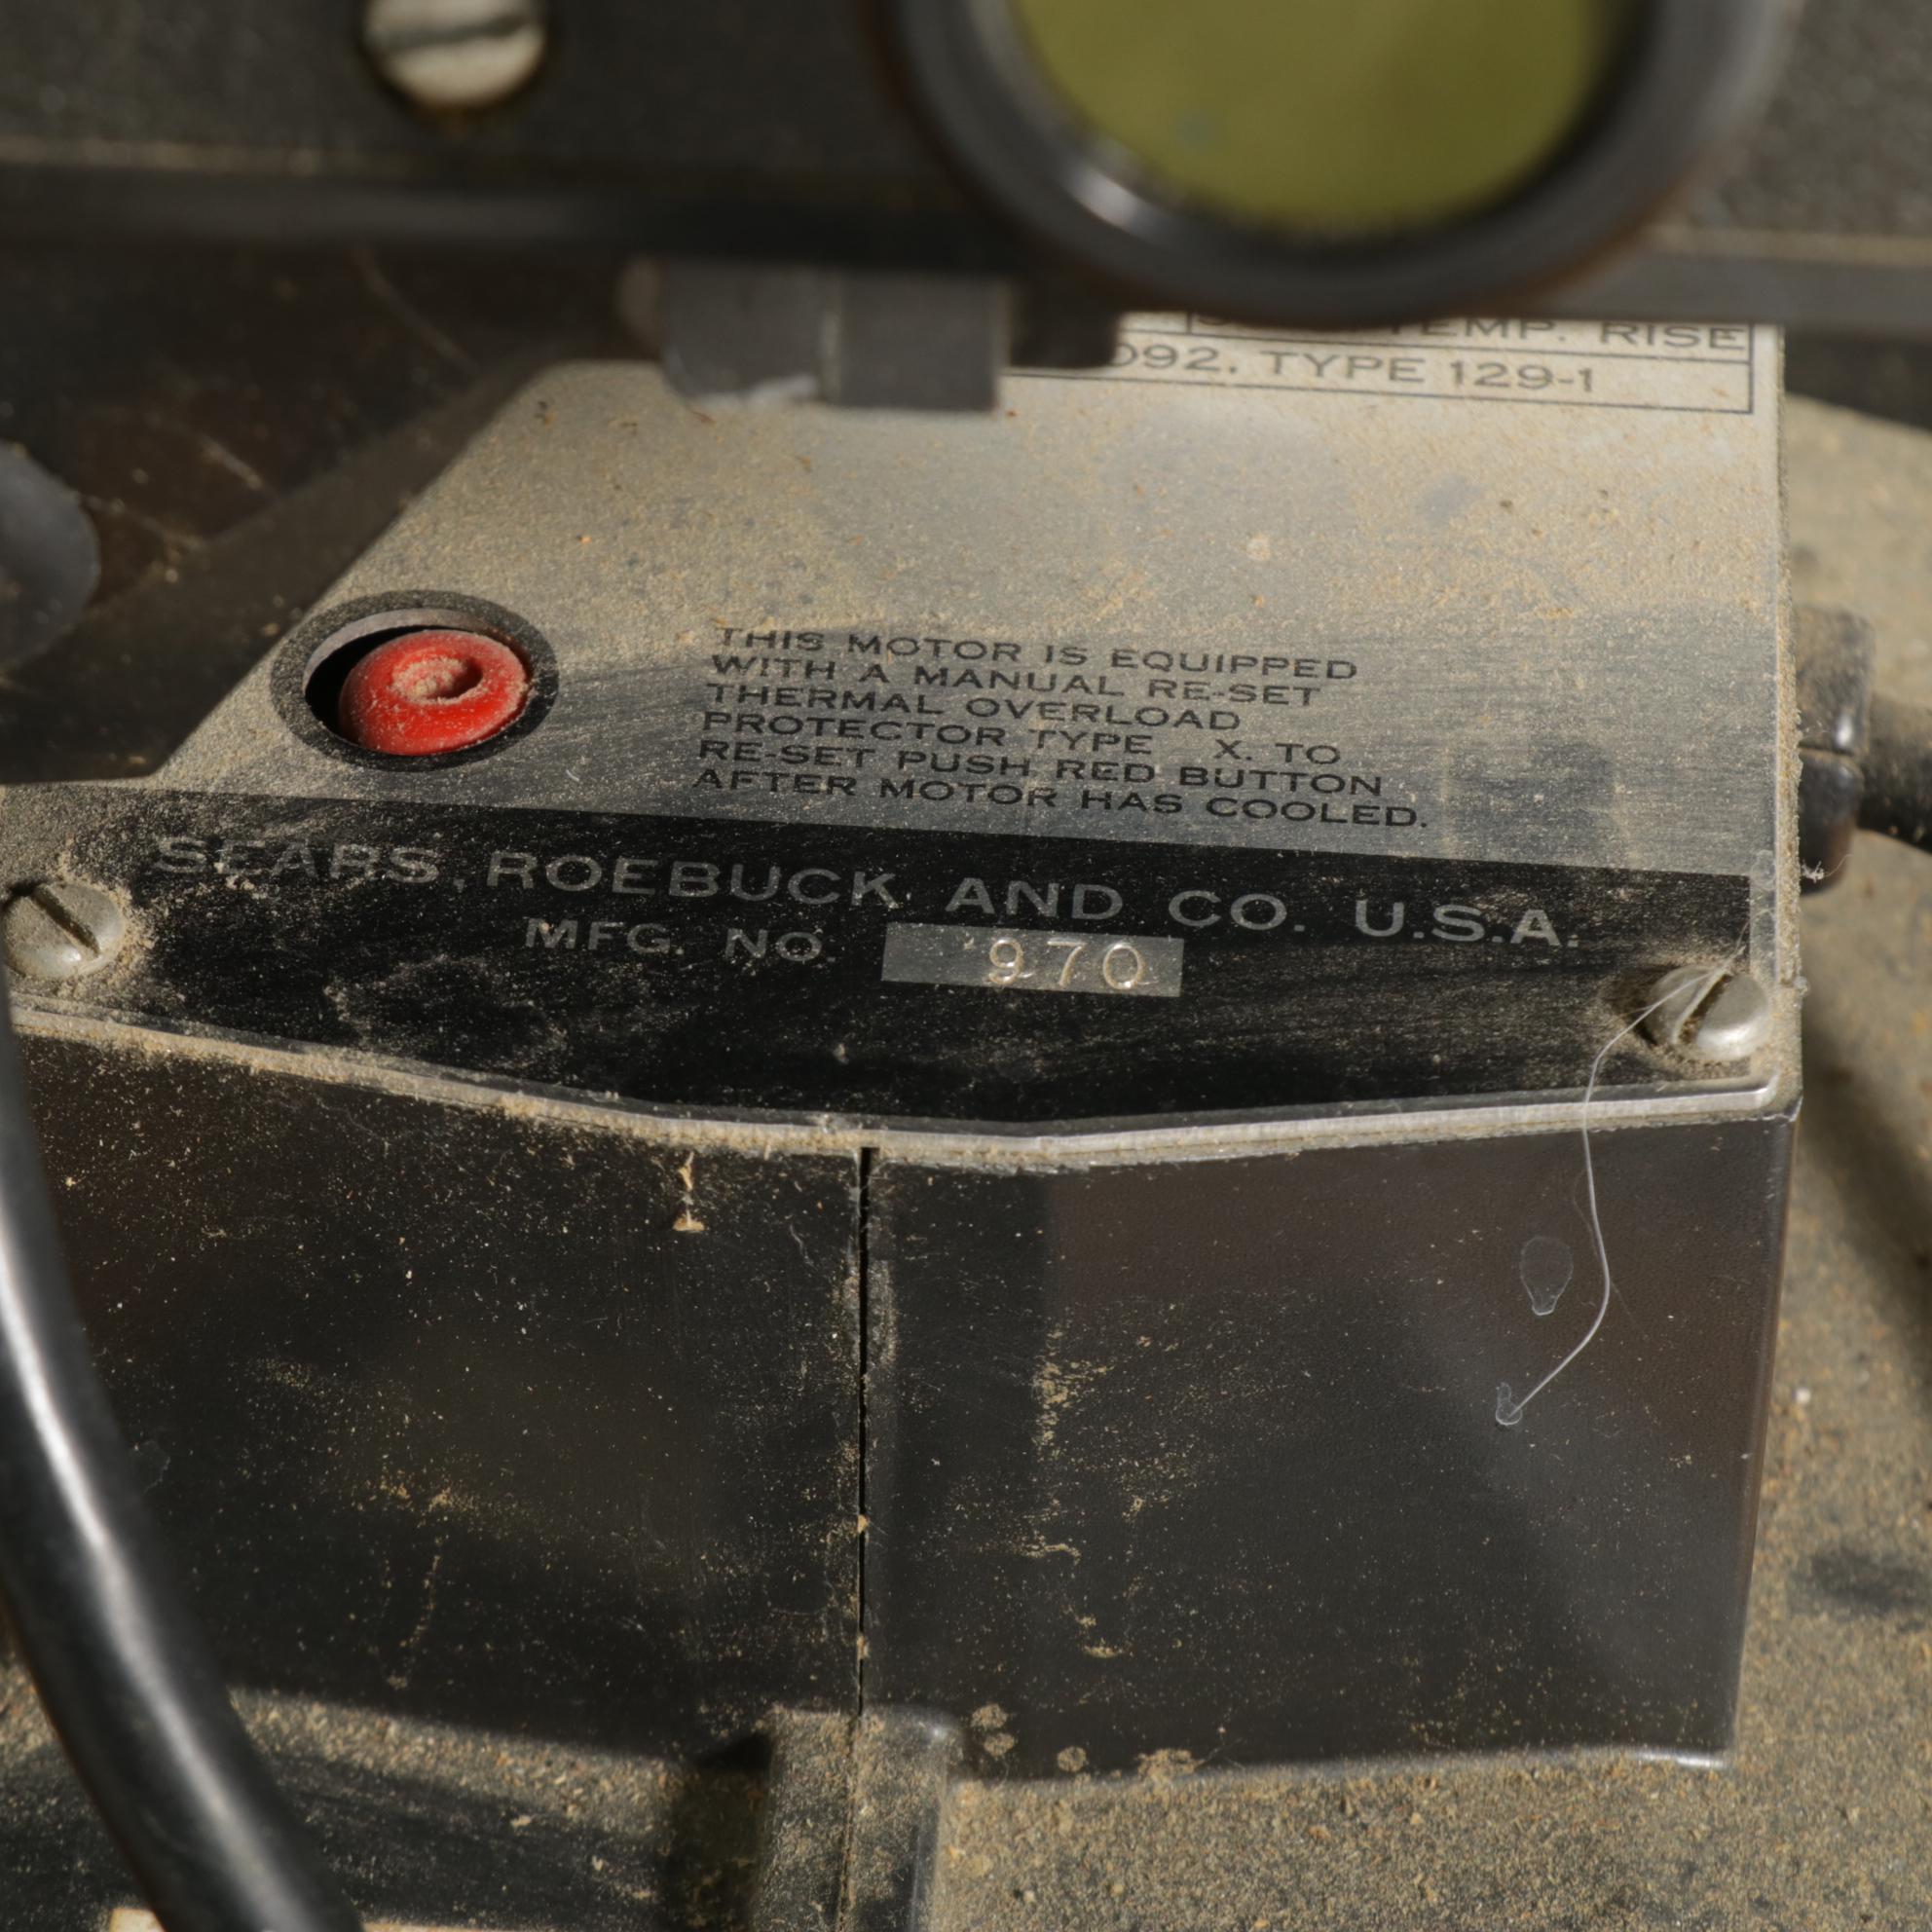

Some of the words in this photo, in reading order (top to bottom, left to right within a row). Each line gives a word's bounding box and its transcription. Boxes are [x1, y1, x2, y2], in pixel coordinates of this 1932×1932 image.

[1600, 321, 1746, 352] RISE
[1260, 350, 1425, 384] TYPE
[1449, 359, 1594, 391] 129-1
[712, 654, 836, 681] WITH
[859, 663, 890, 684] A
[913, 665, 1126, 697] MANUAL
[1148, 679, 1321, 707] RE-SET
[721, 627, 825, 652] THIS
[848, 633, 1022, 662] MOTOR
[1045, 645, 1088, 666] IS
[1110, 650, 1357, 681] EQUIPPED
[706, 683, 945, 715] THERMAL
[965, 697, 1241, 730] OVERLOAD
[702, 711, 1006, 747] PROTECTOR
[1028, 729, 1154, 756] TYPE
[1212, 738, 1253, 762] X.
[1275, 742, 1341, 765] TO
[698, 739, 876, 769] RE-SET
[897, 750, 1030, 778] PUSH
[1056, 759, 1156, 784] RED
[1178, 766, 1383, 797] BUTTON
[691, 768, 858, 797] AFTER
[878, 778, 1058, 807] MOTOR
[1080, 789, 1183, 814] HAS
[1206, 797, 1428, 828] COOLED.
[945, 876, 1124, 919] AND
[1169, 890, 1307, 932] CO.
[1354, 898, 1579, 947] U.S.A.
[526, 917, 684, 955] MFG.
[725, 927, 836, 962] NO.
[987, 937, 1147, 990] 970
